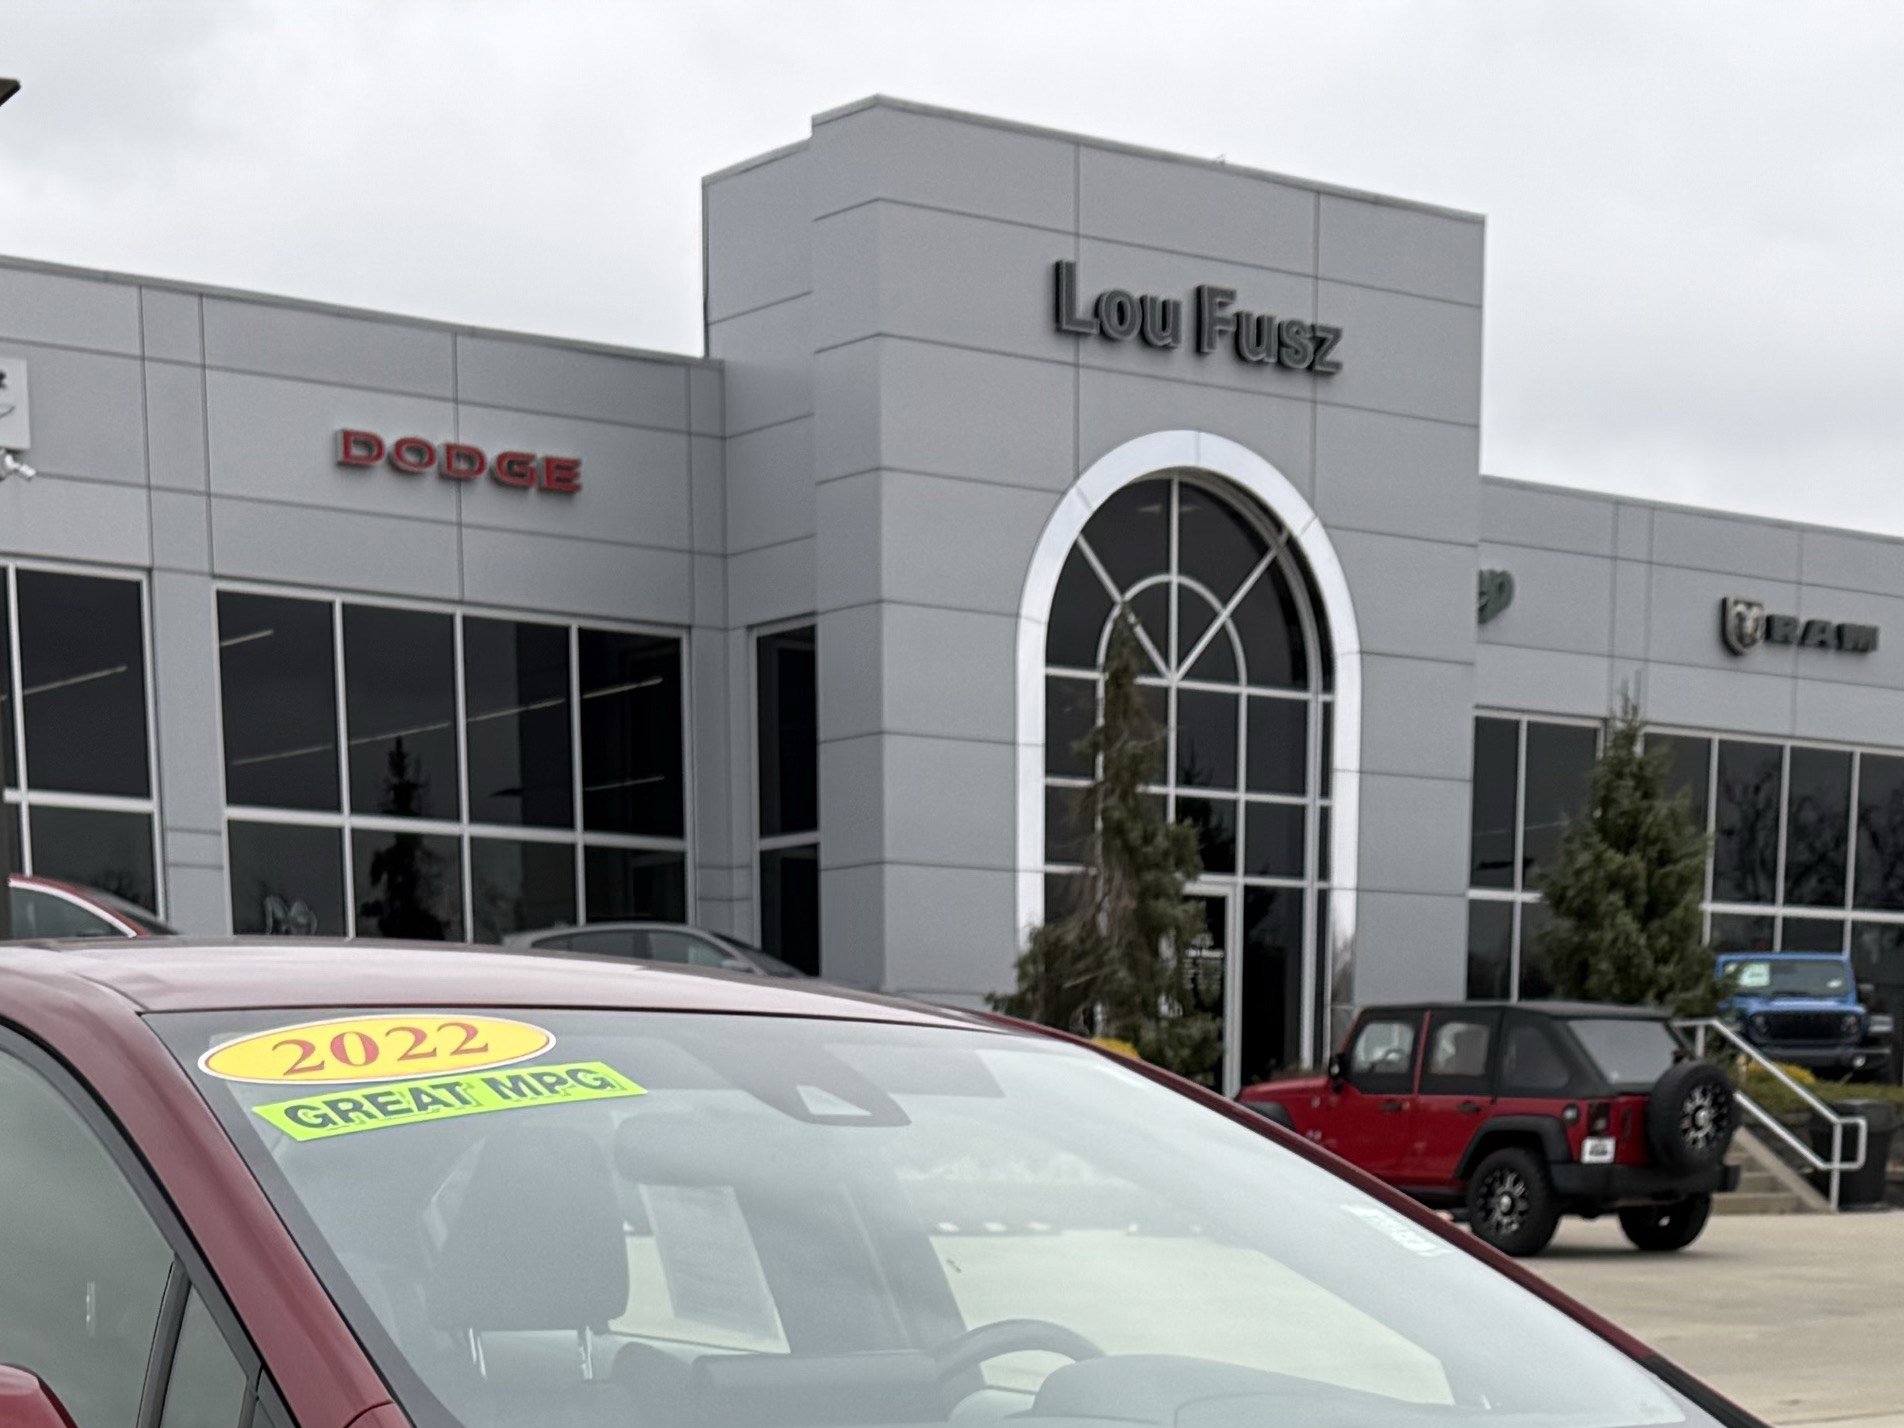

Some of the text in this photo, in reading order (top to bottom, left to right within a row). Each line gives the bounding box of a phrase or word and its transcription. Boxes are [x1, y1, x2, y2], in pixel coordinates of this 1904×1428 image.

[1053, 259, 1344, 374] Lou Fusz
[336, 428, 582, 493] DODGE
[1765, 614, 1879, 652] RAM
[272, 1022, 490, 1077] 2022
[283, 1068, 614, 1130] GREAT MPG
